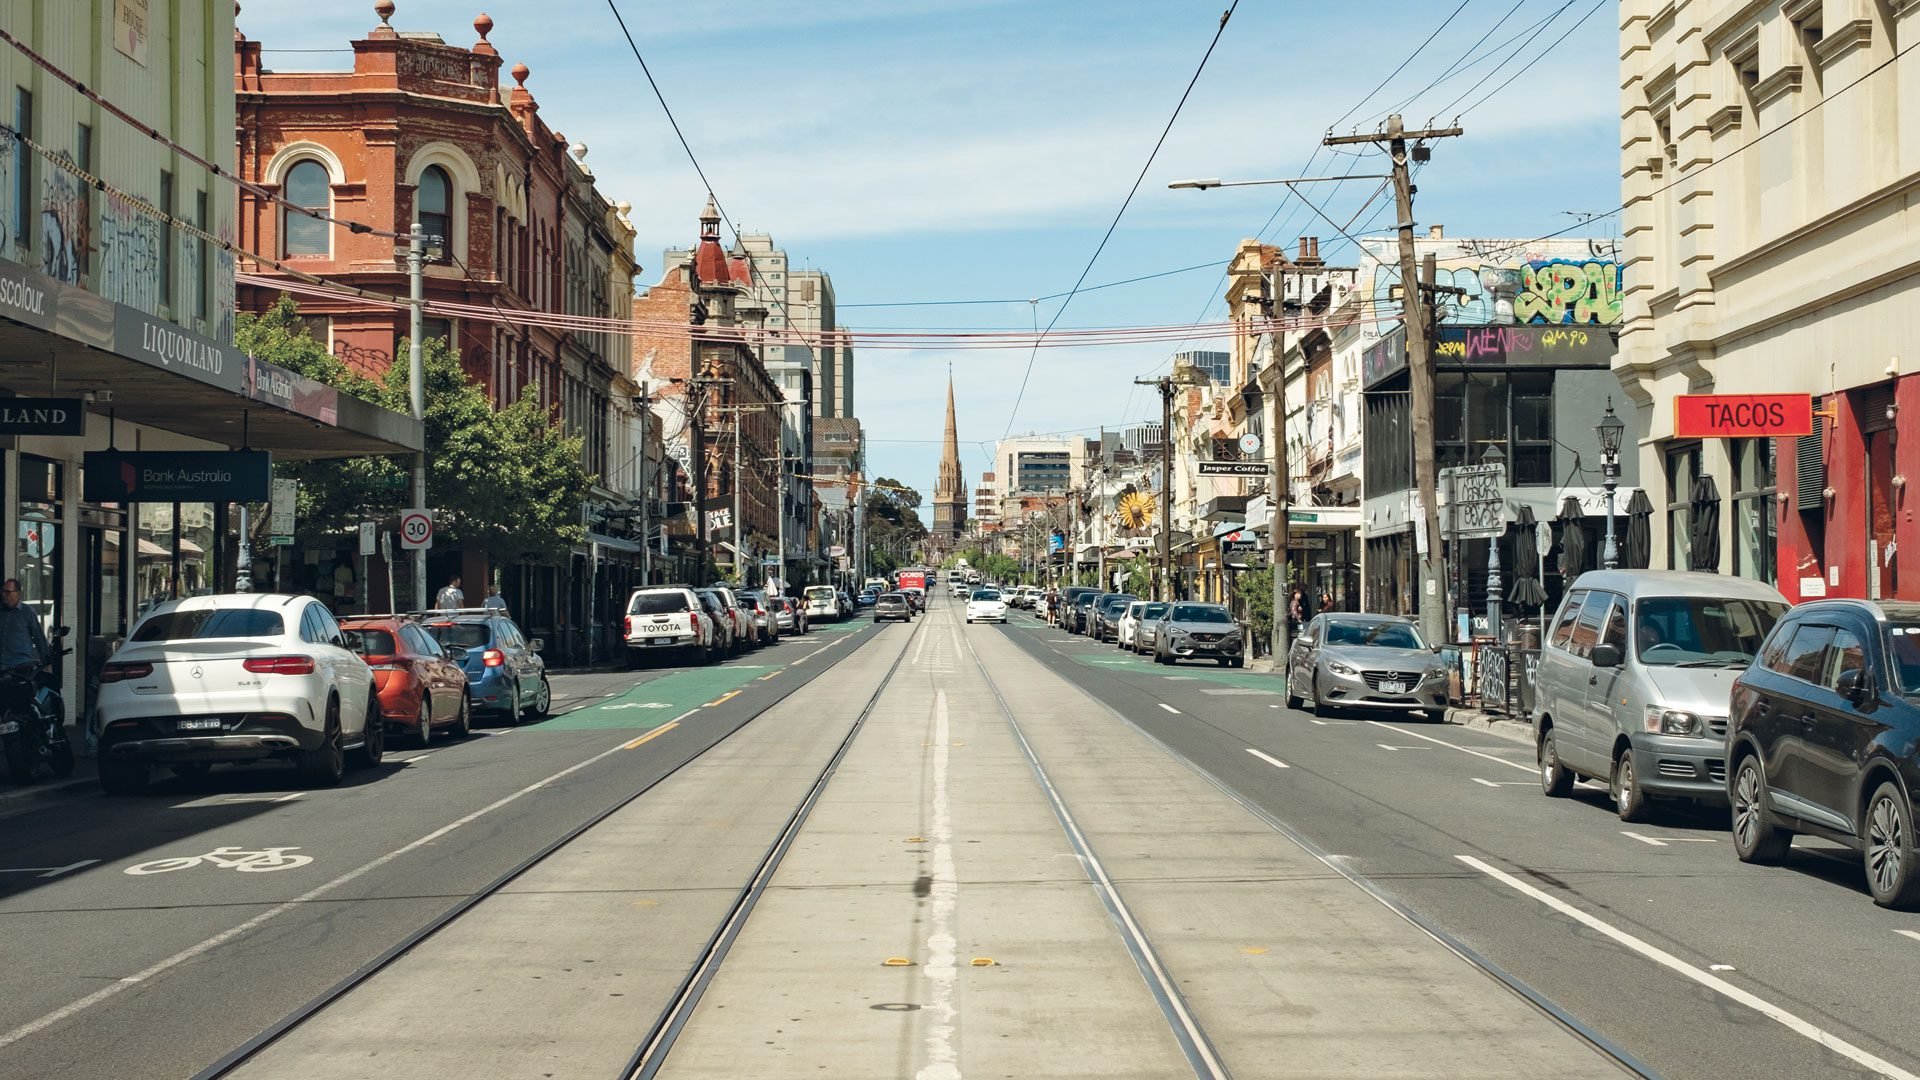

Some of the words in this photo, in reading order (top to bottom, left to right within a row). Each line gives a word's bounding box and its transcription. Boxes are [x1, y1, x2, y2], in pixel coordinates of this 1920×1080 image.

[143, 323, 222, 375] LIQUORLAND
[3, 408, 67, 424] LAND
[1705, 403, 1785, 428] TACOS
[144, 469, 174, 482] Bank
[177, 469, 231, 482] Australia
[1203, 465, 1232, 473] Jasper
[1234, 465, 1266, 473] Coffee
[408, 523, 426, 535] 30
[642, 624, 681, 632] TOYOTA
